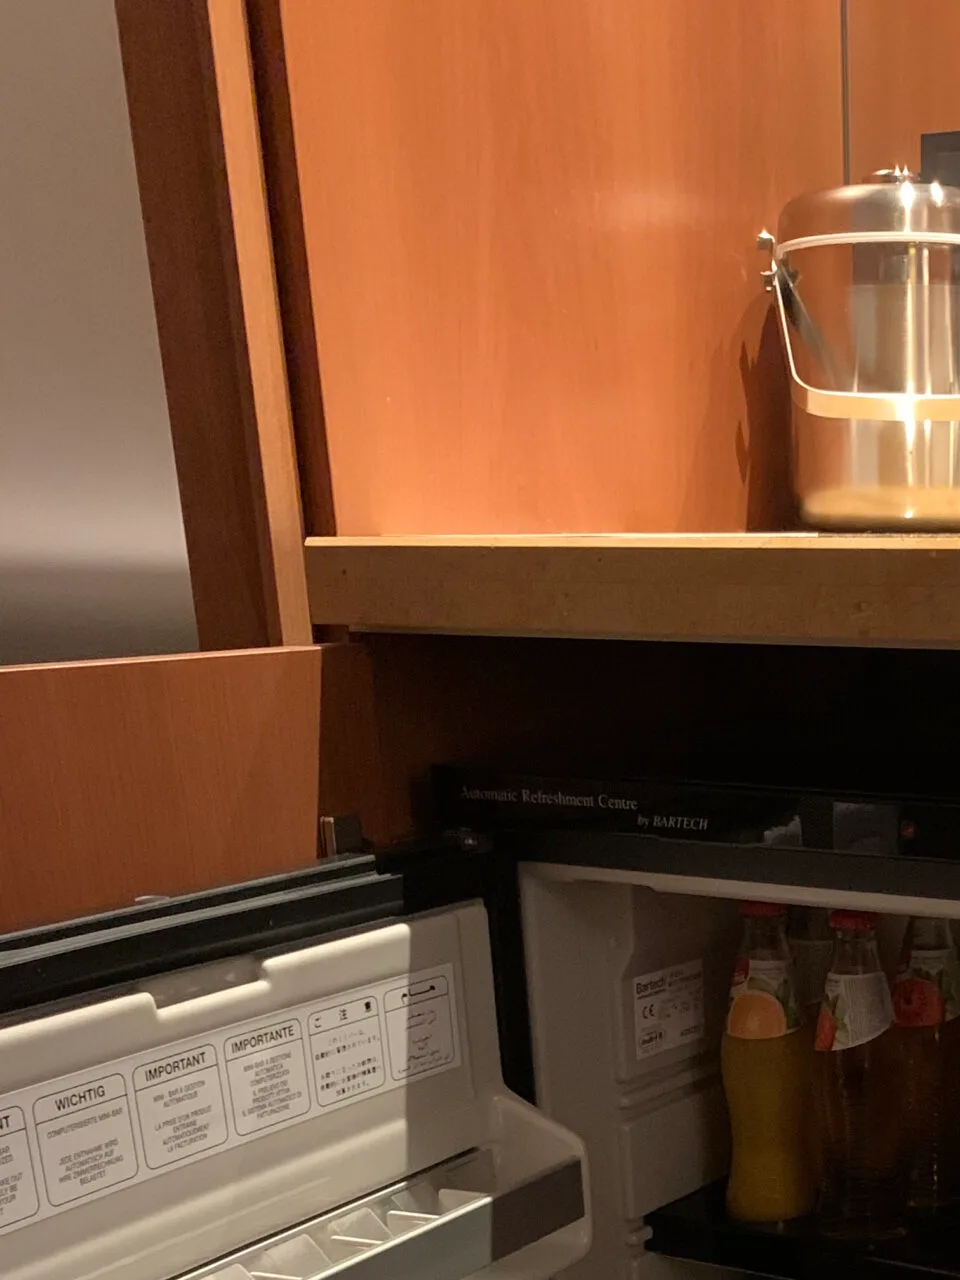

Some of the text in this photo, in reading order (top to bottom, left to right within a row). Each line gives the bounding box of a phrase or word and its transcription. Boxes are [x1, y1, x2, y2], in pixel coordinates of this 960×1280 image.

[460, 785, 639, 810] Automatic Refreshment Centre
[637, 813, 709, 831] by BARTECH
[231, 1025, 295, 1054] IMPORTANTE
[145, 1052, 206, 1082] IMPORTANT
[54, 1085, 106, 1112] WICHTIG
